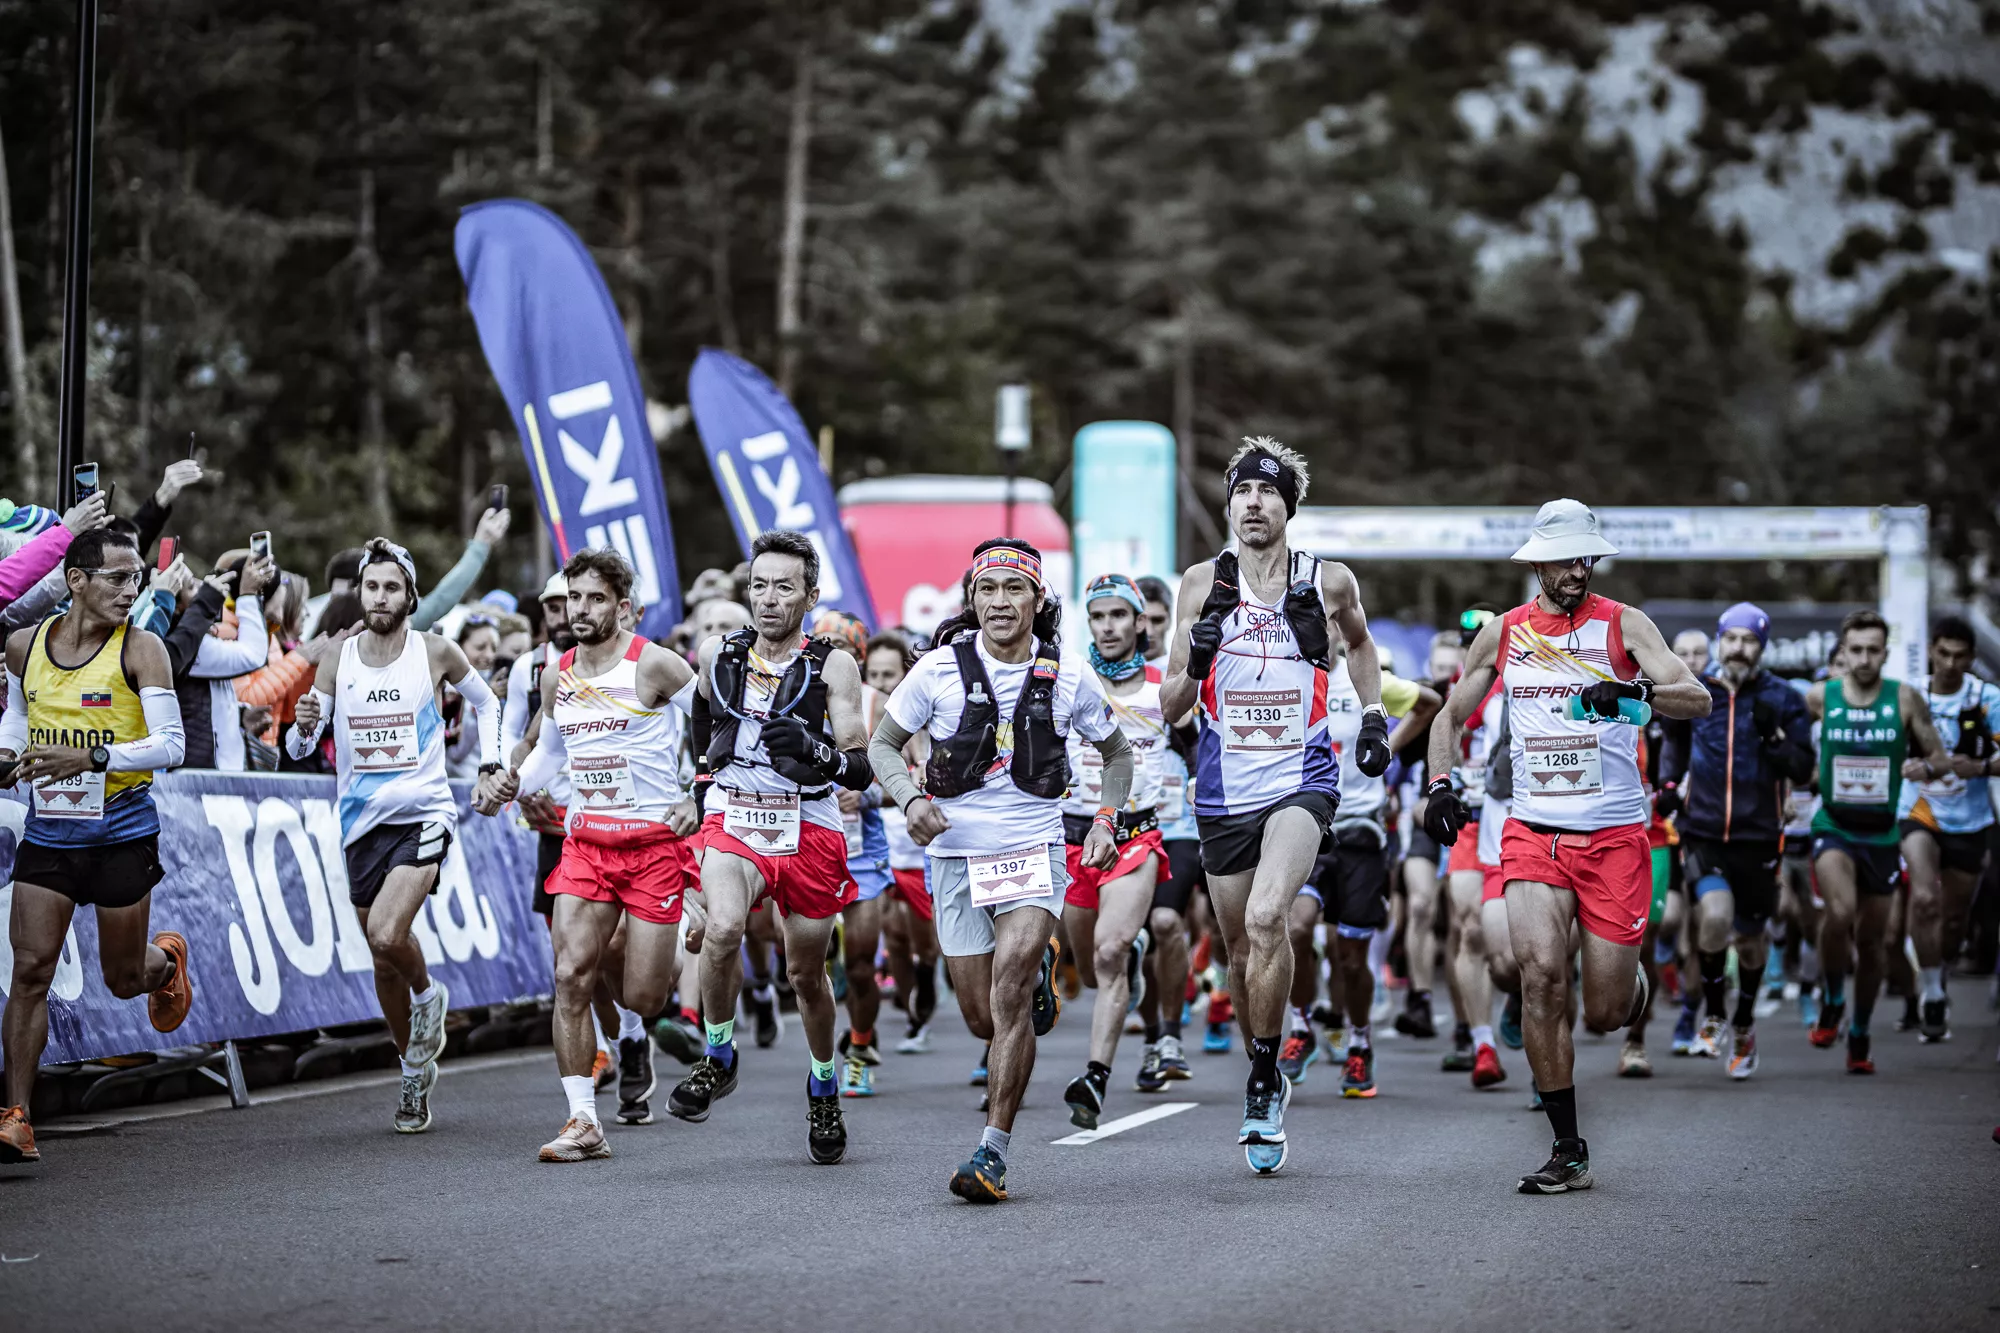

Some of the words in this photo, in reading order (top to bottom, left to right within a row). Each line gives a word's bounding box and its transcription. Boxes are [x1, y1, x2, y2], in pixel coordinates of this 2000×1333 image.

[1243, 628, 1290, 643] BRITAIN
[366, 689, 401, 702] ARG
[1227, 693, 1283, 701] LONGDISTANCE
[1284, 692, 1299, 700] 34K
[1512, 683, 1584, 699] ESPAÑ
[350, 716, 398, 726] LONGDISTANCE
[398, 714, 412, 722] 34K
[1244, 708, 1281, 721] 1330
[558, 717, 630, 736] ESPAÑA
[366, 729, 397, 743] 1374
[1827, 728, 1897, 742] IRELAND
[1527, 739, 1579, 747] LONGDISTANCE
[1544, 752, 1579, 767] 1268
[583, 771, 613, 784] 1329
[745, 810, 777, 825] 1119
[991, 859, 1027, 875] 1397
